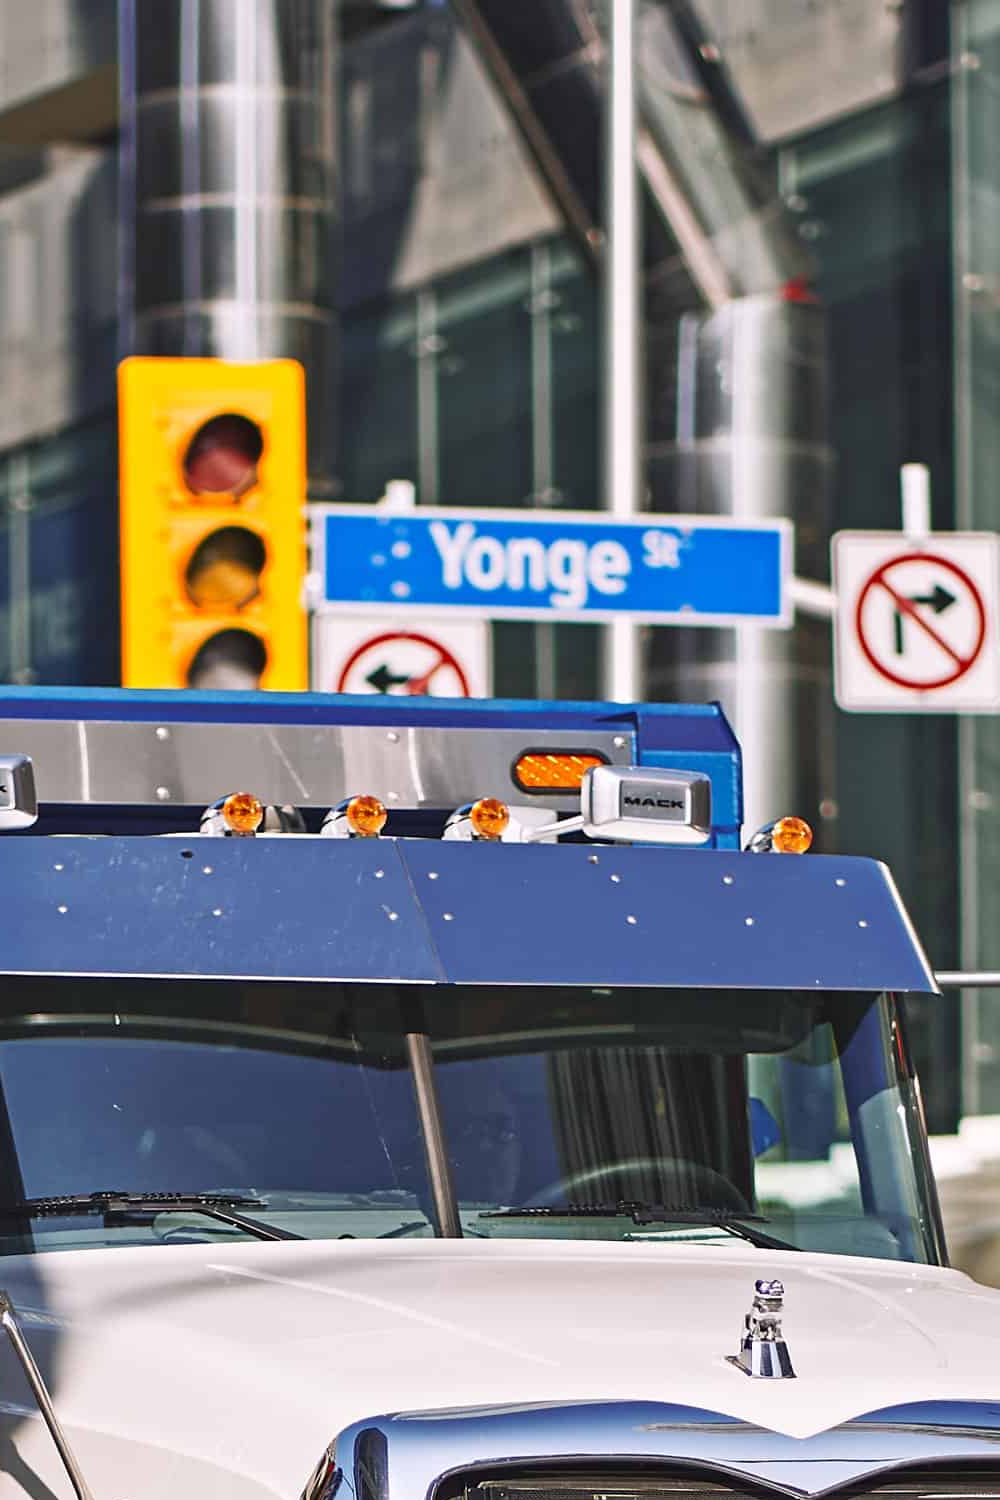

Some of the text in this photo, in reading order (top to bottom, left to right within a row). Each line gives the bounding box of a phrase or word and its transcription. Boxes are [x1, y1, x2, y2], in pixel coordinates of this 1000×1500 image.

[428, 521, 681, 609] Yonge St
[624, 797, 684, 808] MACK
